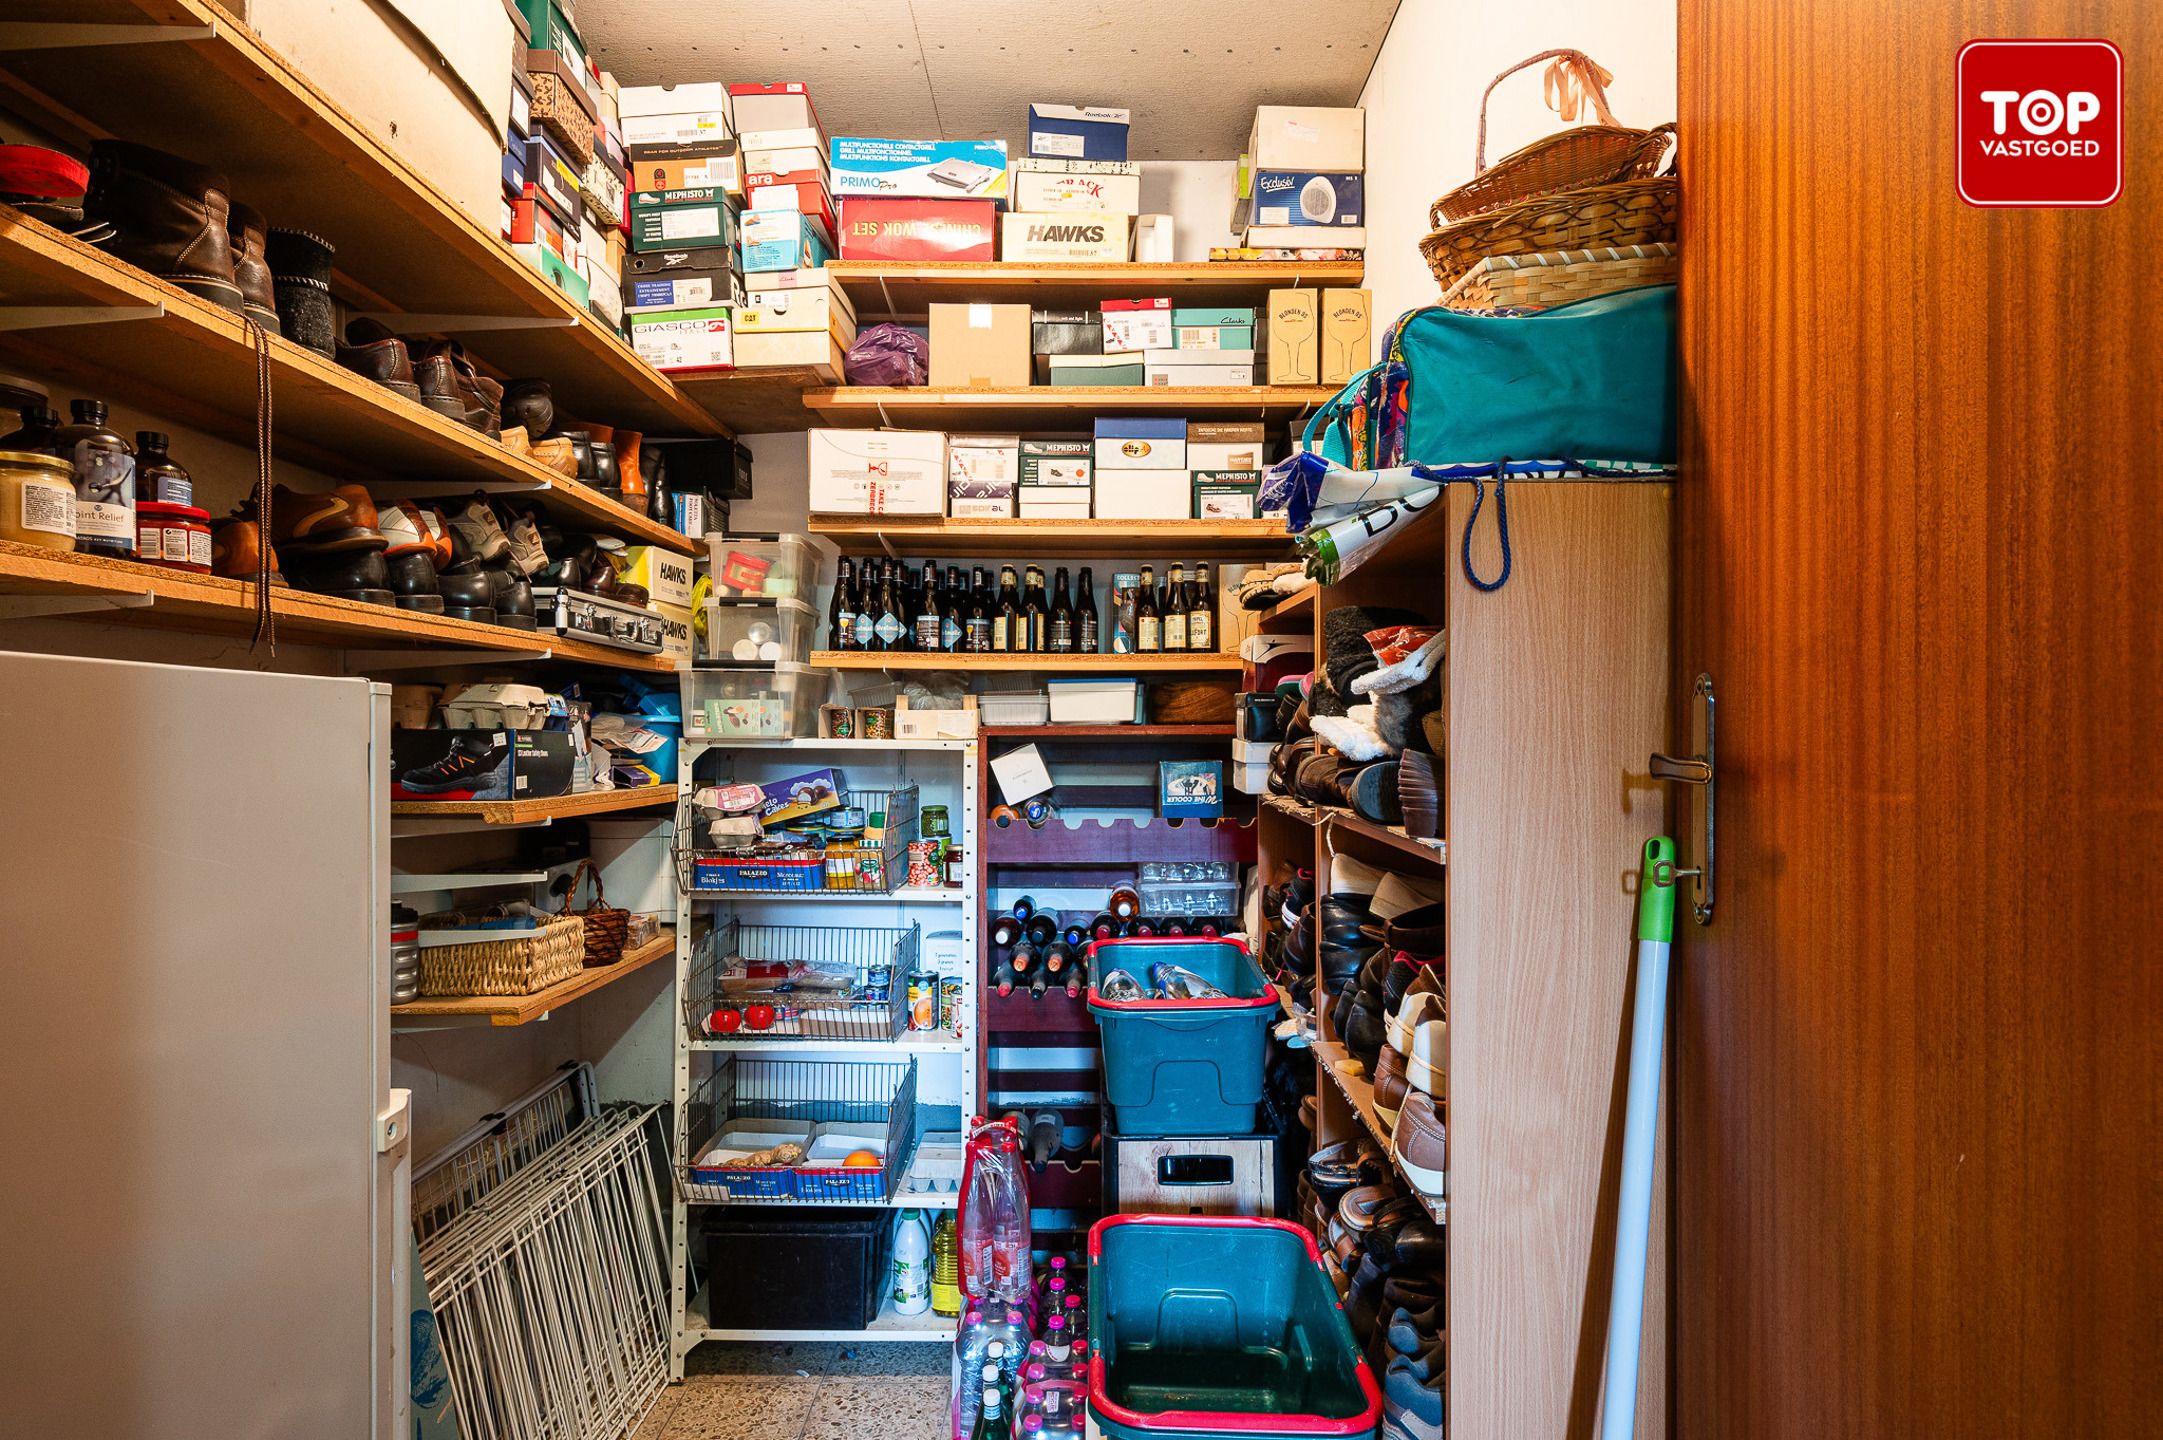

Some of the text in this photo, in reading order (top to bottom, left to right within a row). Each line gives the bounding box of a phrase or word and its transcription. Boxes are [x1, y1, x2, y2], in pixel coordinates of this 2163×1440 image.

[748, 174, 773, 185] ara
[840, 176, 898, 191] PRIMO Pro
[665, 190, 704, 201] MEPHISTO
[852, 221, 878, 236] SET
[1026, 225, 1105, 243] HAWKS
[634, 319, 707, 334] GIASCO
[1046, 443, 1081, 453] MEPHISTO
[1215, 472, 1248, 481] MEPHISTO
[98, 511, 124, 522] Relief
[660, 561, 687, 585] HAWKS
[663, 617, 688, 642] HAWKS
[765, 801, 790, 816] Cakes
